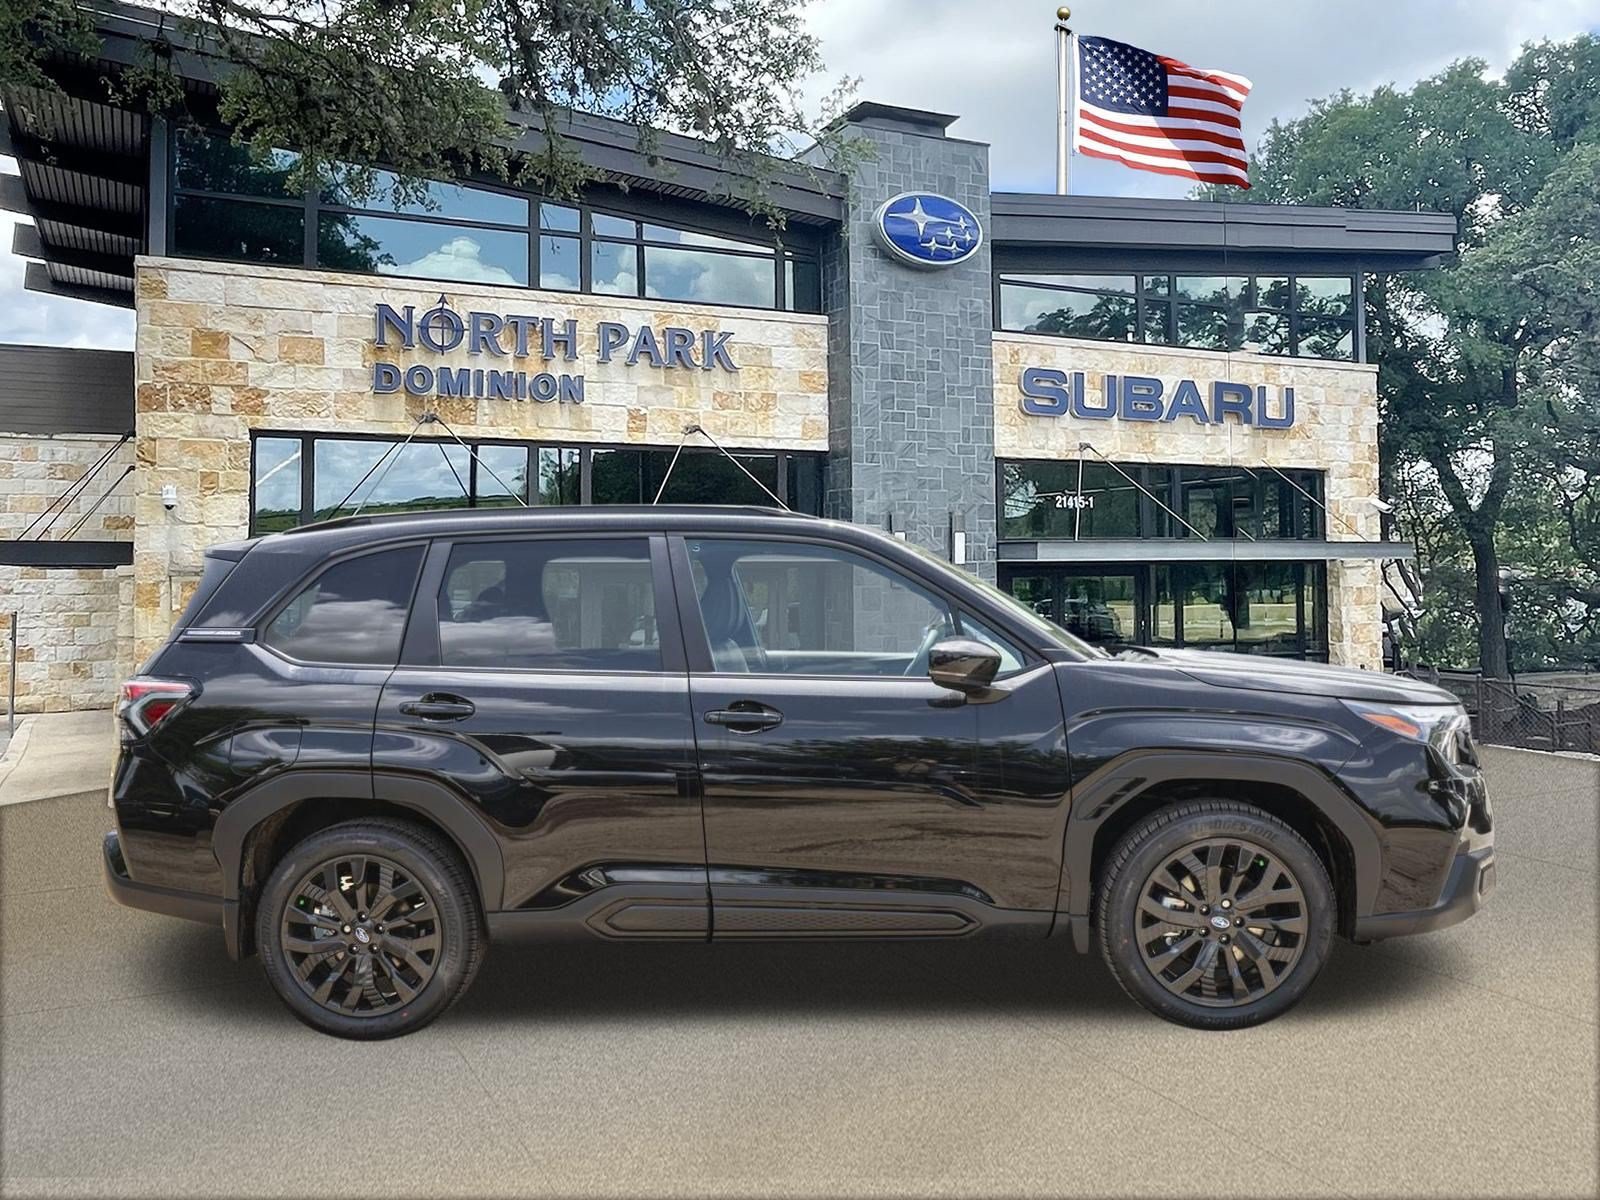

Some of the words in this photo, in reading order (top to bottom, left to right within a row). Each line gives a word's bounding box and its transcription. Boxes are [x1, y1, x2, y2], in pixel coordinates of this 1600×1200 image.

[375, 299, 579, 362] NORTH
[597, 321, 741, 372] PARK
[373, 363, 585, 403] DOMINION
[1020, 367, 1294, 430] SUBARU
